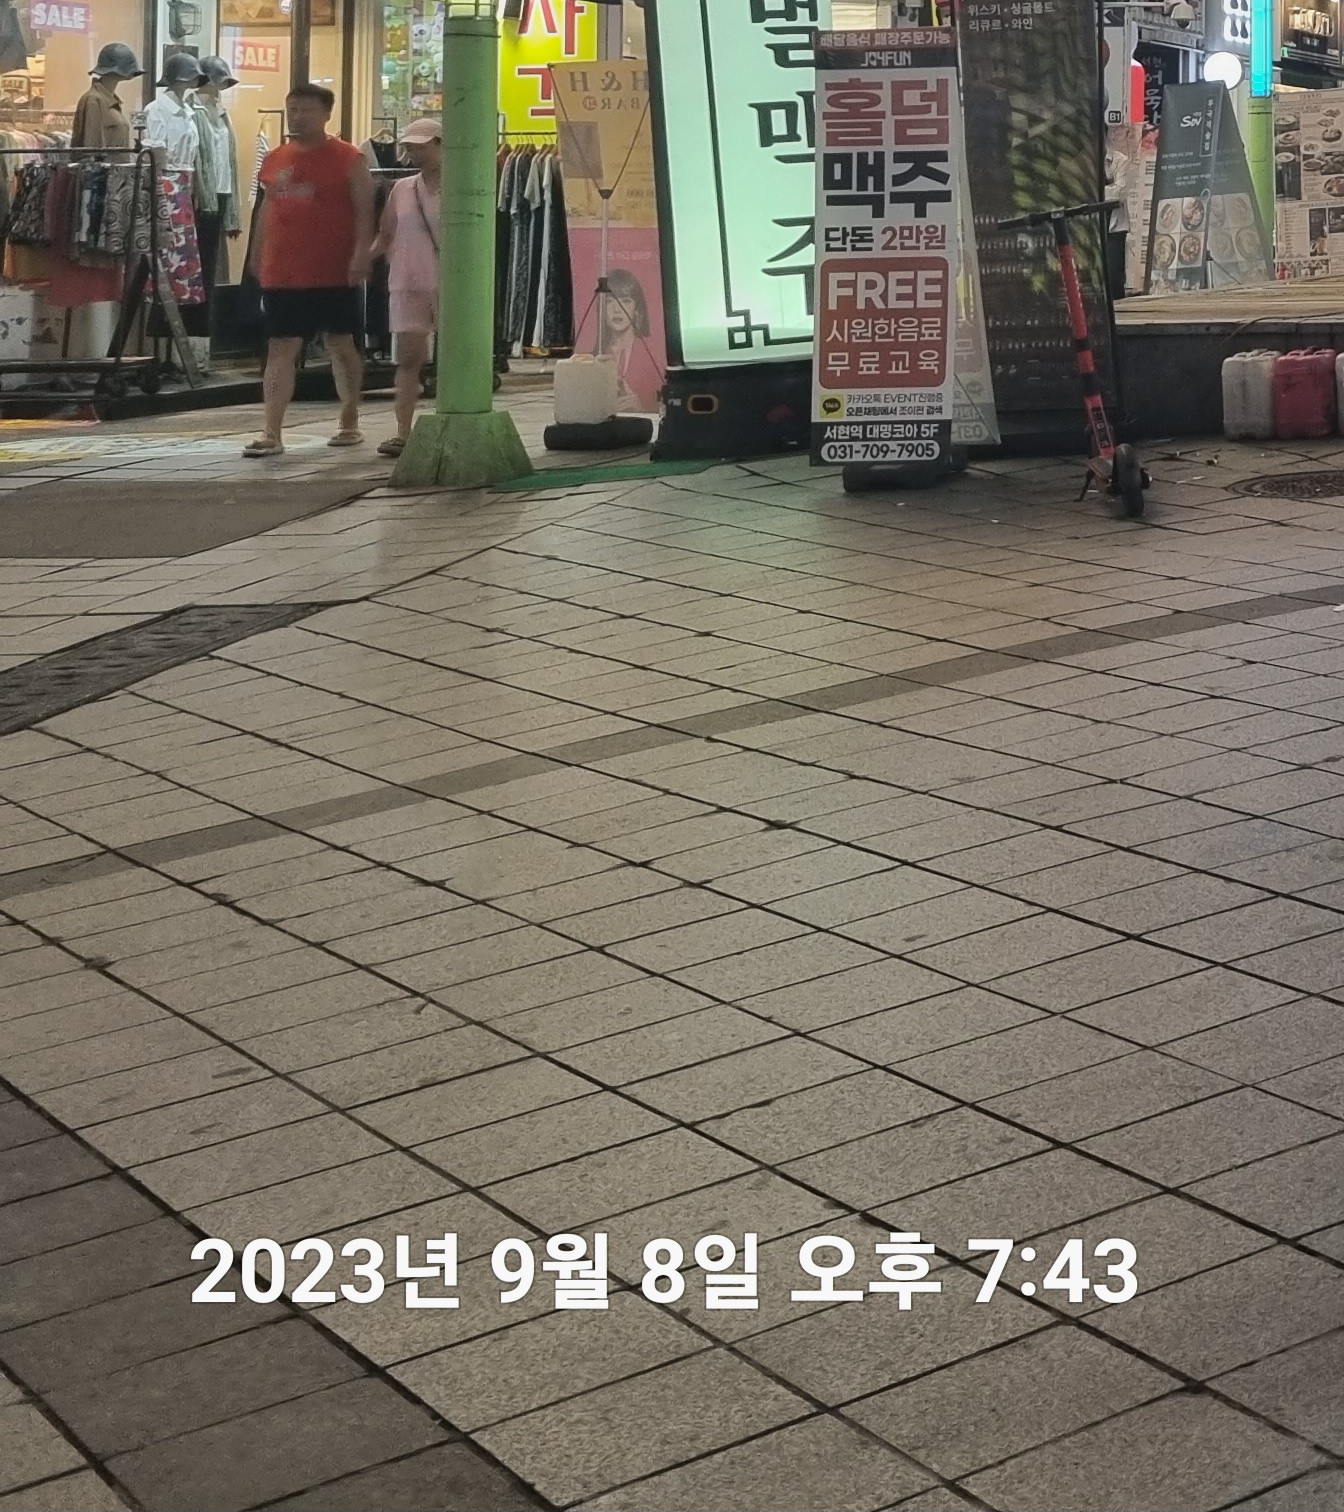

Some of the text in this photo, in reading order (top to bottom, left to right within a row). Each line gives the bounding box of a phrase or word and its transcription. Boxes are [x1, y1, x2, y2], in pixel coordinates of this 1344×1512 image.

[33, 3, 88, 29] SALE
[234, 44, 278, 69] SALE
[822, 78, 949, 146] 홀덤
[822, 150, 951, 218] 맥주
[825, 225, 946, 252] 단돈 2만원
[828, 270, 942, 310] FREE
[826, 318, 942, 343] 시원한음료
[824, 425, 863, 439] 서현역
[921, 424, 939, 437] 5F
[827, 443, 935, 459] 031-709-7905
